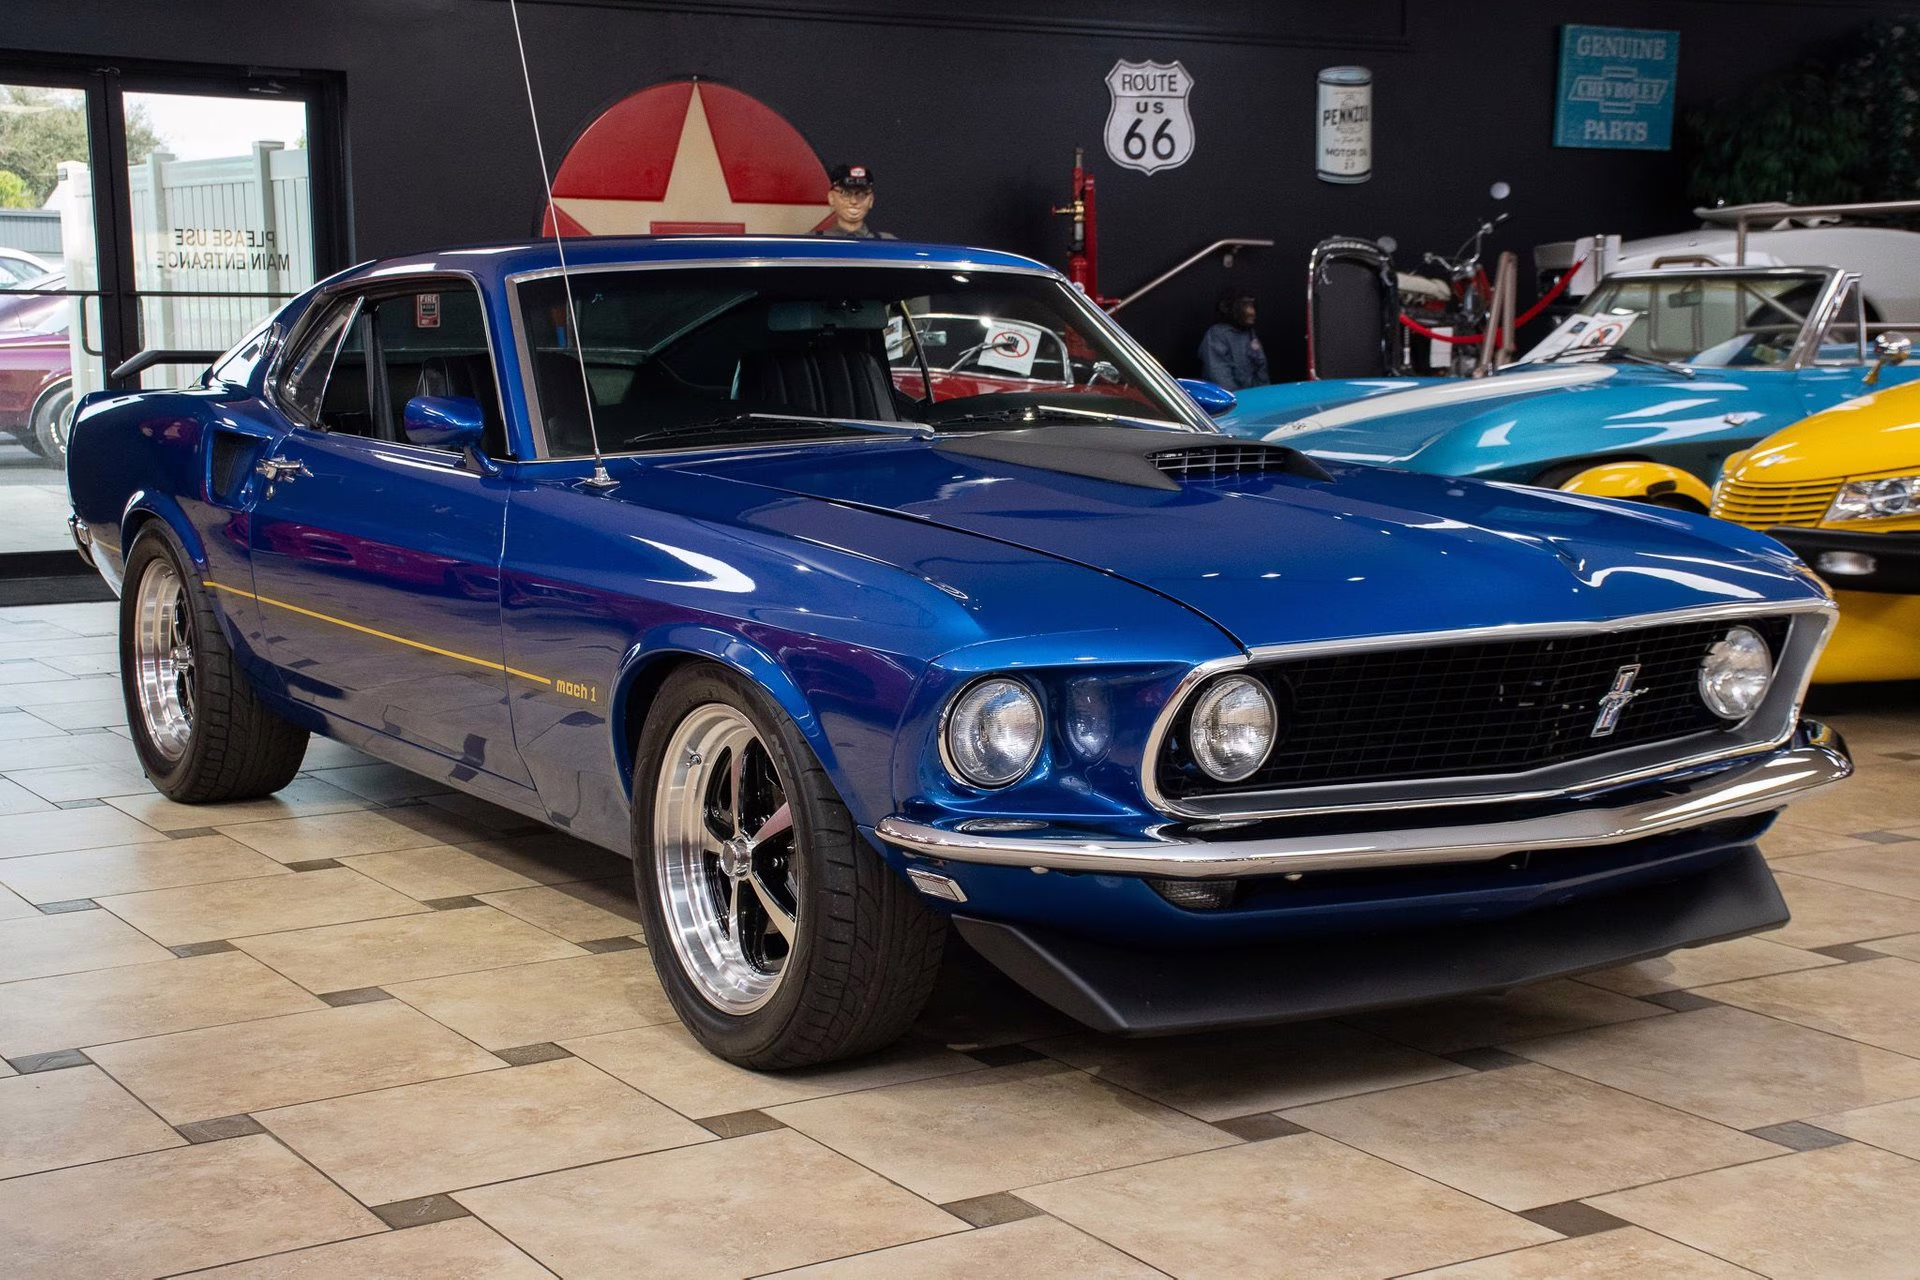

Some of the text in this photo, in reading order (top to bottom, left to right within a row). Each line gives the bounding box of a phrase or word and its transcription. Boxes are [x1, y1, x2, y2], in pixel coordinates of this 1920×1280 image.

[1576, 35, 1667, 60] GENUINE
[1121, 73, 1178, 92] ROUTE
[1577, 80, 1662, 101] CHEVROLET
[1135, 101, 1165, 114] US
[1123, 117, 1176, 161] 66
[1583, 118, 1649, 142] PARTS
[556, 679, 597, 702] mach 1
